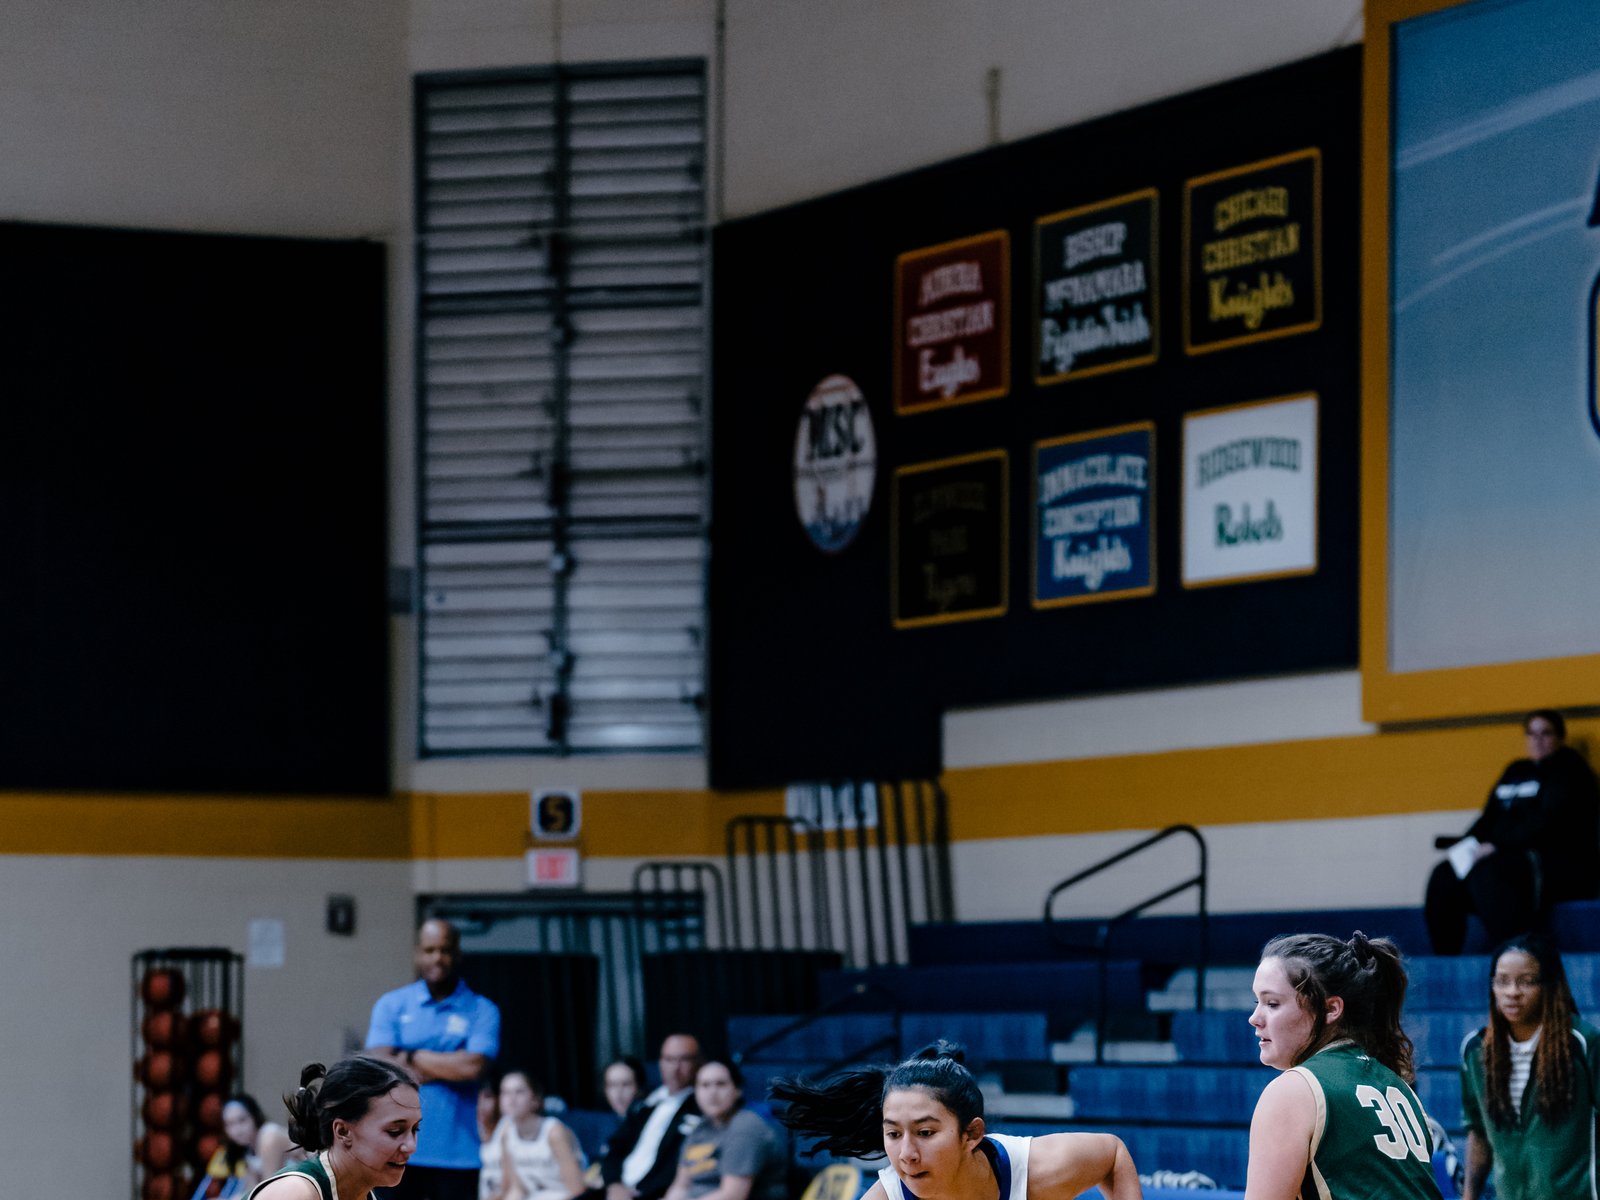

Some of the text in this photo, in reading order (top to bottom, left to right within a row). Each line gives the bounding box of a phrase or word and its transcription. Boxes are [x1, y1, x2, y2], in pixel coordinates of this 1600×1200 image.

[1201, 222, 1301, 274] CHRISTIAN
[1039, 452, 1148, 506] IMMACULATE
[1196, 437, 1301, 490] RIDGEWOOD
[1042, 496, 1141, 539] CONCEPTION
[1052, 534, 1133, 591] Knights
[1355, 1084, 1431, 1163] 30
